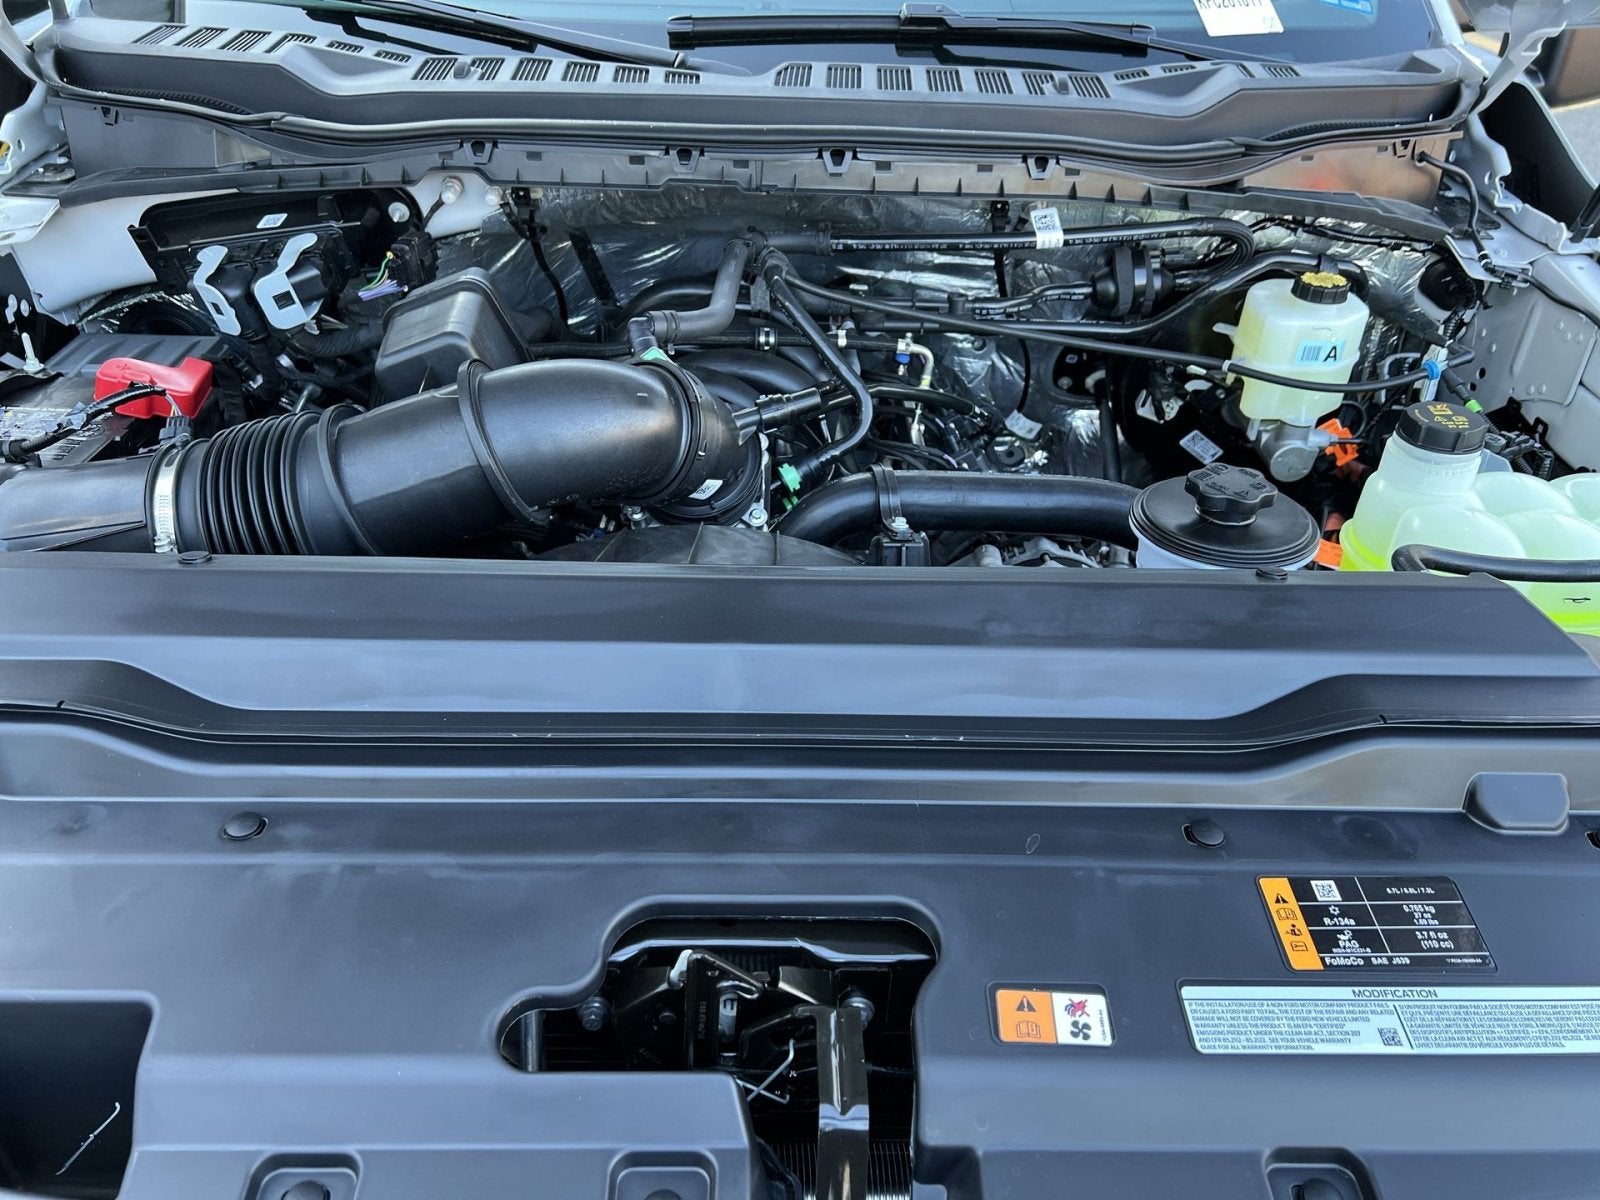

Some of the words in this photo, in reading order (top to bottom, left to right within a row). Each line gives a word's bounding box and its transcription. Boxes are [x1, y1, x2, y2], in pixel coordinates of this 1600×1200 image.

[1323, 346, 1338, 362] A
[1424, 904, 1435, 913] kg
[1323, 918, 1356, 926] R-134a
[1415, 931, 1428, 940] 3.7
[1429, 931, 1436, 939] fl
[1338, 940, 1360, 948] PAG
[1421, 940, 1439, 950] (110
[1440, 940, 1454, 950] cc)
[1324, 957, 1364, 966] FoMoCo
[1371, 957, 1389, 965] SAE
[1352, 989, 1438, 998] MODIFICATION
